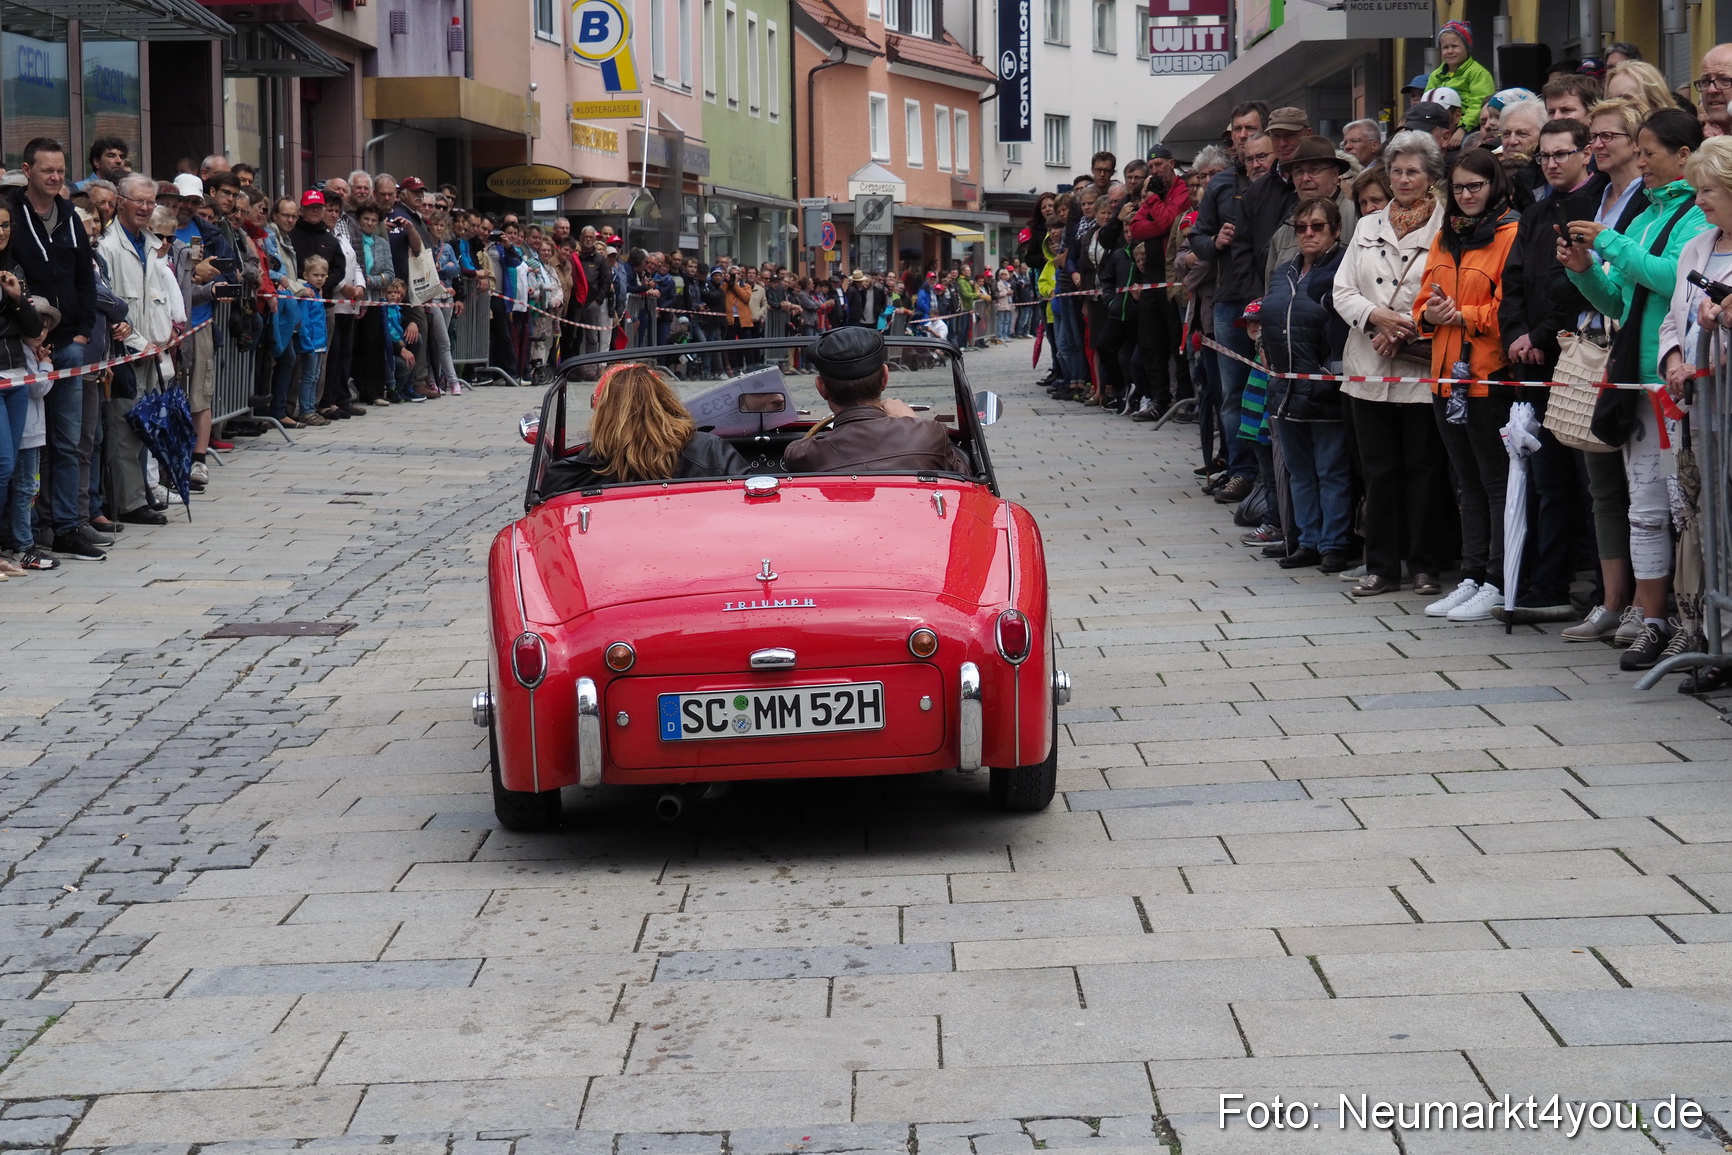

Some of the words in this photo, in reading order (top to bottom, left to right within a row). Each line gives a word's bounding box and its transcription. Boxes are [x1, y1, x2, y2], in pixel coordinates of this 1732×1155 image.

[1350, 3, 1375, 11] MODE
[1376, 3, 1382, 11] &
[1384, 2, 1429, 11] LIFESTYLE
[579, 11, 610, 43] B
[1019, 1, 1029, 73] TAILOR
[1152, 27, 1225, 52] WITT
[17, 44, 54, 88] CECIL
[1151, 54, 1227, 73] WEIDEN
[576, 105, 630, 114] KLOSTERGASSE
[1019, 76, 1029, 129] TOM
[491, 179, 505, 187] DIE
[506, 178, 571, 187] GOLDSCHMIEDE
[725, 598, 814, 610] TRIUMPH
[682, 698, 729, 734] SC
[754, 694, 801, 730] MM
[810, 688, 881, 726] 52H
[667, 722, 676, 732] D
